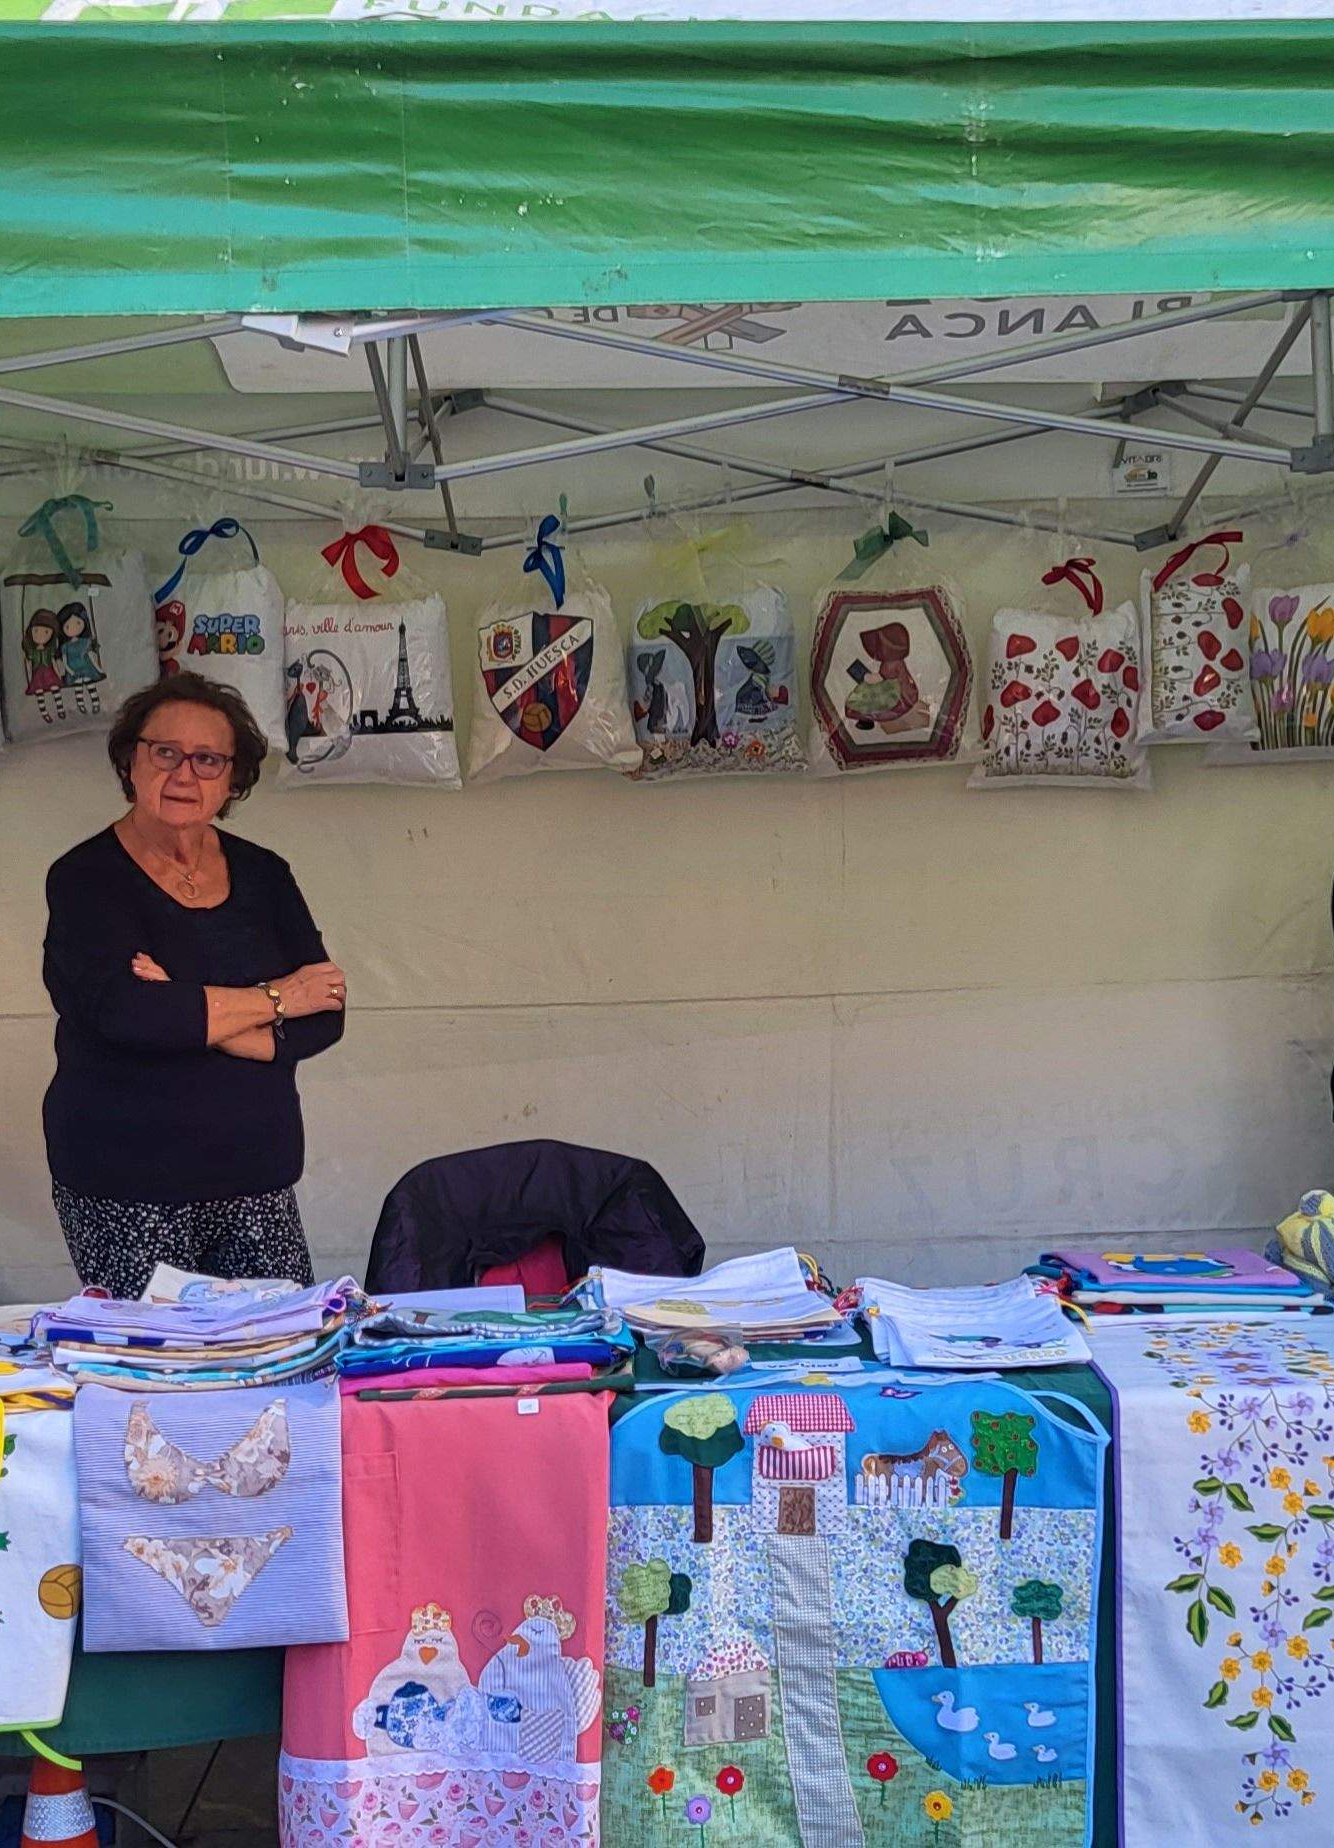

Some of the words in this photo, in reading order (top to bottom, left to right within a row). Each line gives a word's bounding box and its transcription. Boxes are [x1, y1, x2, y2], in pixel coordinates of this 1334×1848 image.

[192, 612, 262, 634] SUPER
[312, 616, 339, 636] ville
[343, 616, 395, 634] d'amour
[187, 632, 267, 655] MARIO
[527, 635, 580, 680] HUESCA
